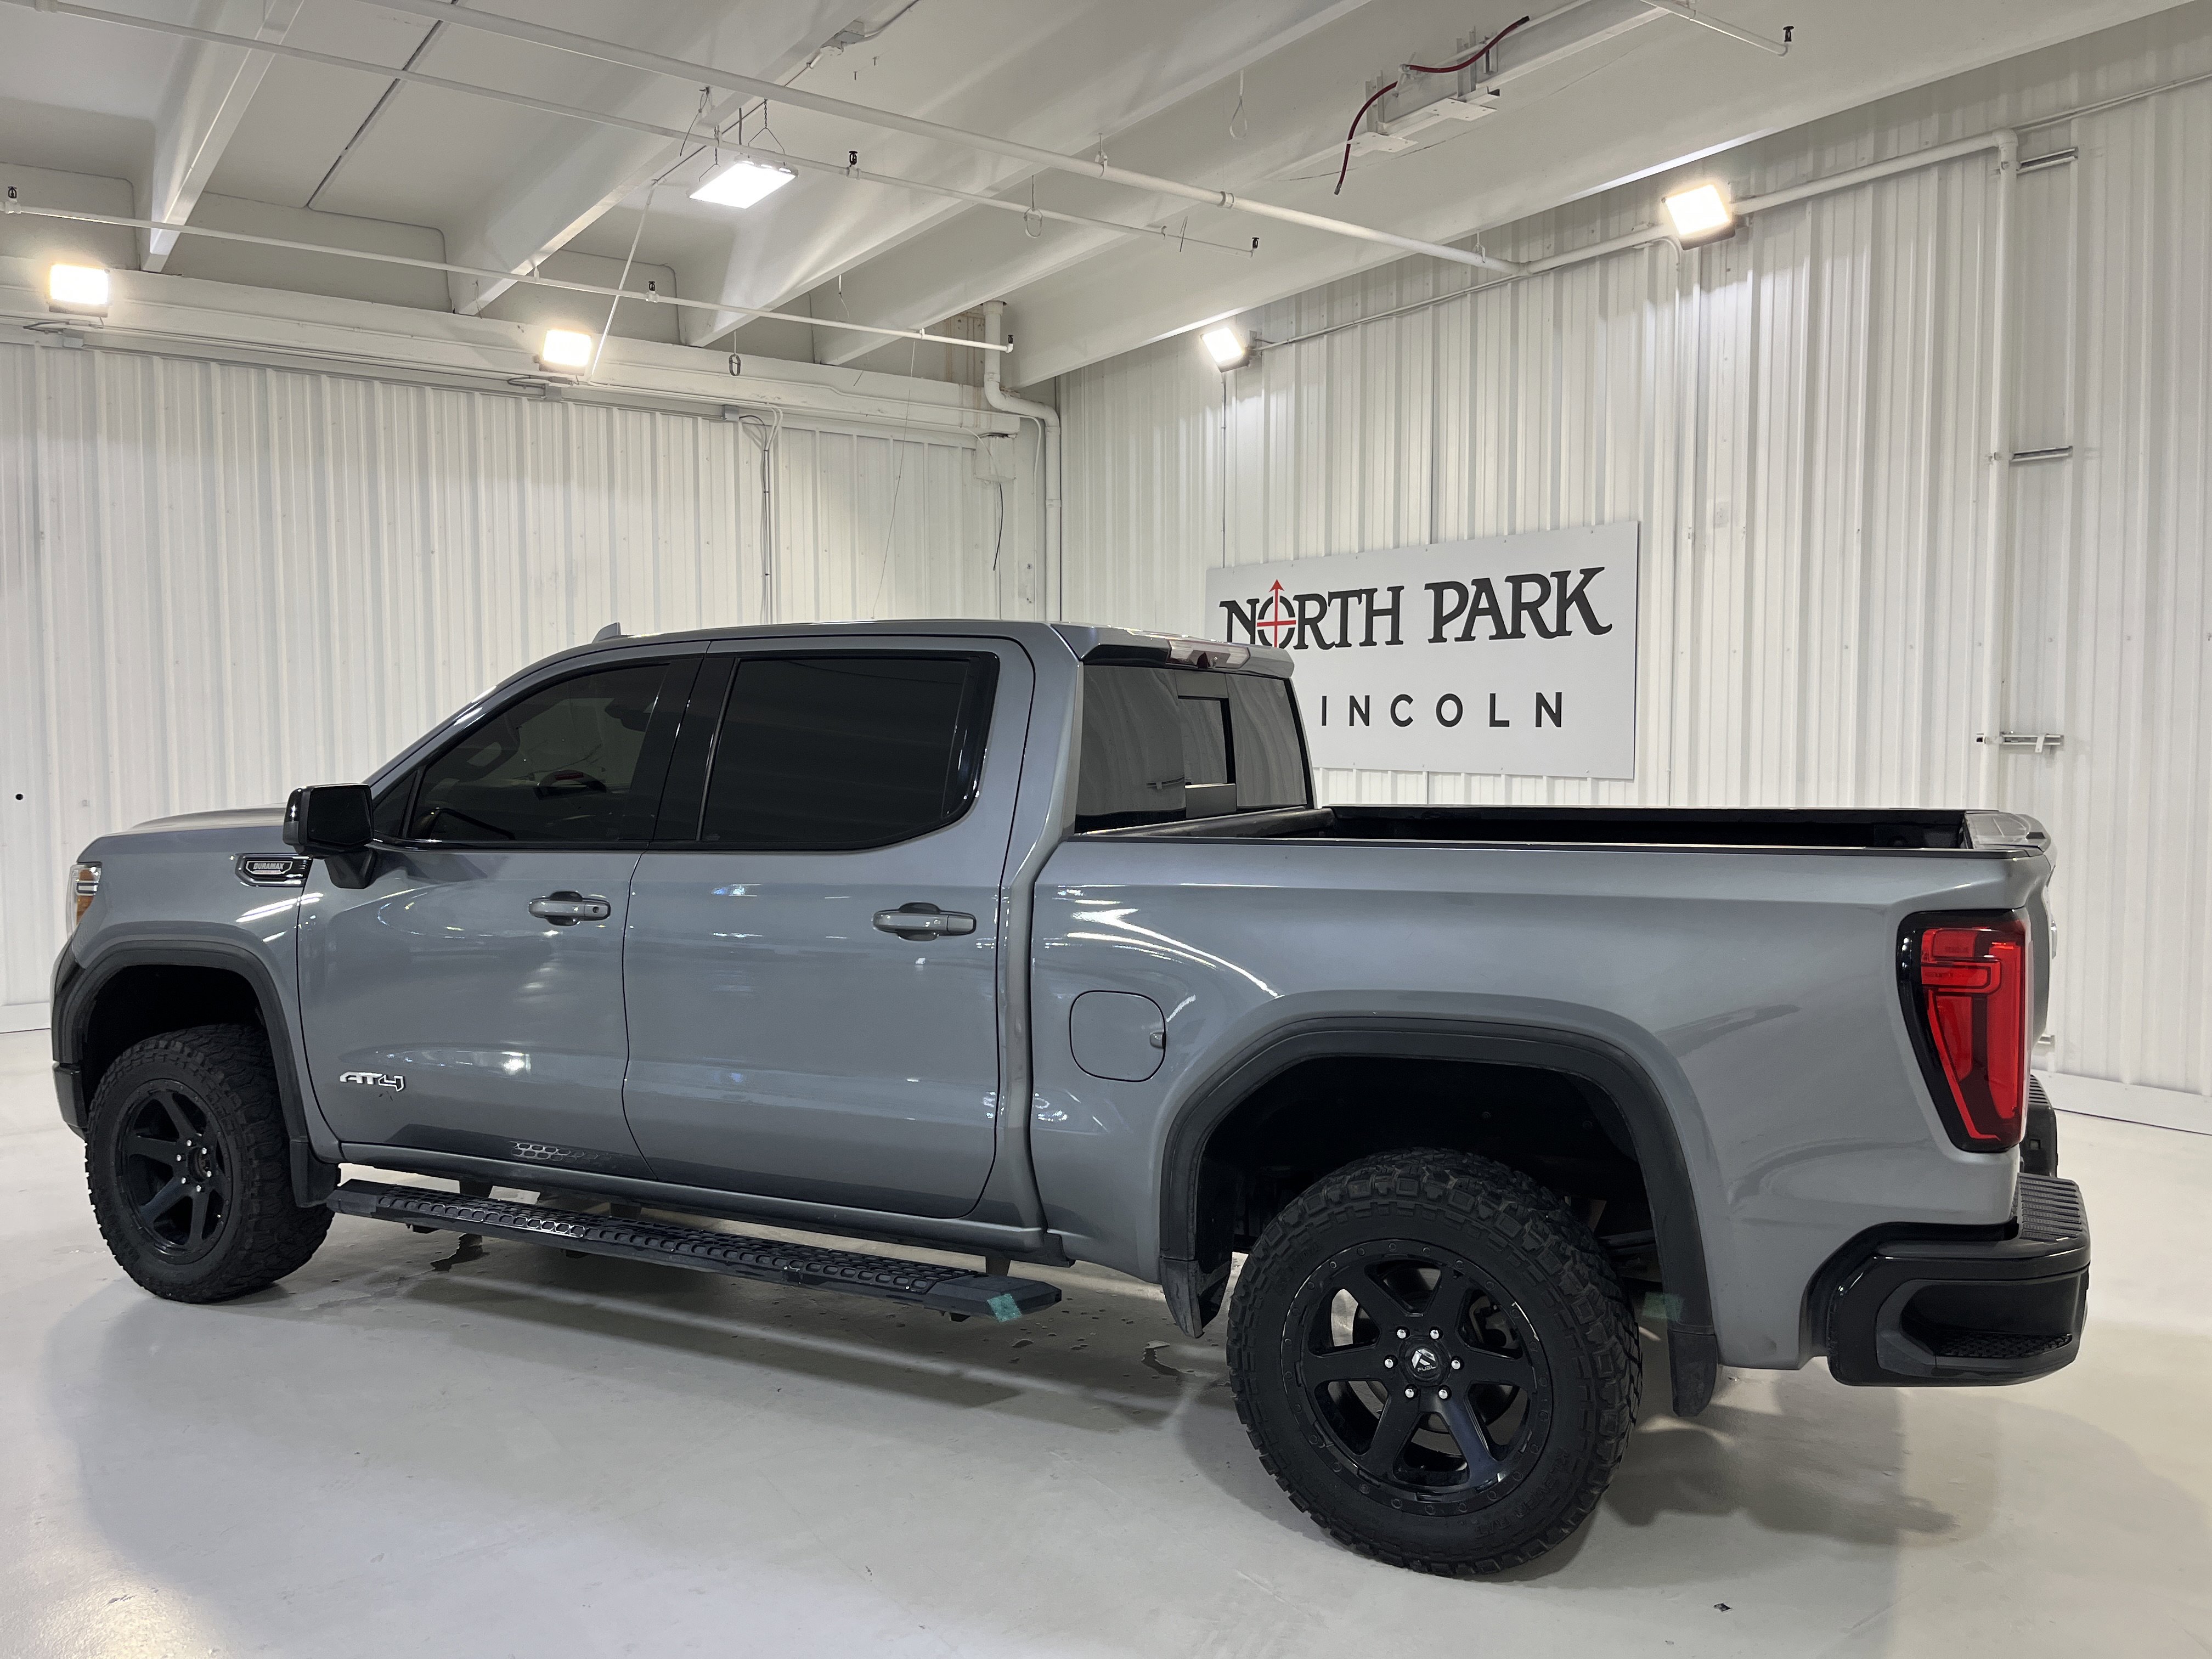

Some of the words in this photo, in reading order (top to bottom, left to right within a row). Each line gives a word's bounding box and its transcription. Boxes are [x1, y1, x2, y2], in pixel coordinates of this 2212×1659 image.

[1218, 585, 1404, 651] NORTH
[1425, 566, 1613, 644] PARK
[1321, 692, 1563, 728] INCOLN
[340, 1070, 405, 1092] AT4
[1514, 1444, 1571, 1518] KLEVER
